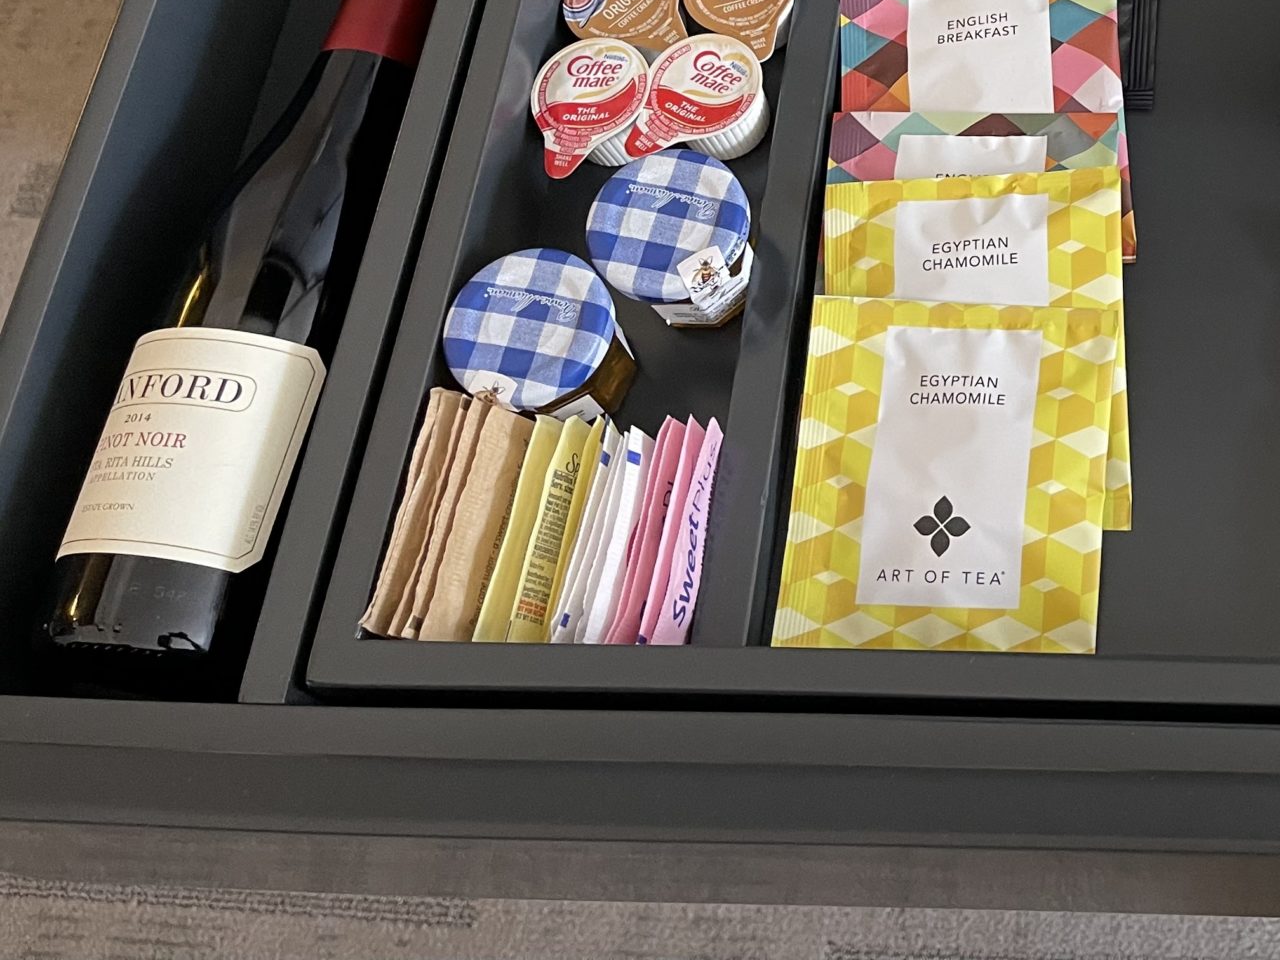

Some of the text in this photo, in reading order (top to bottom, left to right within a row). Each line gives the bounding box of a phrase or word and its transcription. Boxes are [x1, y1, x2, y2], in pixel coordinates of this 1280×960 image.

[723, 3, 746, 14] COFFEE
[947, 12, 1008, 30] ENGLISH
[937, 25, 1019, 45] BREAKFAST
[567, 55, 622, 77] Coffee
[694, 50, 742, 85] Coffee
[572, 76, 615, 88] mate
[690, 72, 729, 93] mate
[665, 102, 706, 122] ORIGINAL
[680, 101, 699, 112] THE
[563, 112, 610, 121] ORIGINAL
[932, 237, 1009, 254] EGYPTIAN
[922, 253, 1019, 272] CHAMOMILE
[920, 375, 999, 389] EGYPTIAN
[909, 392, 1006, 406] CHAMOMILE
[124, 412, 152, 423] 2014
[135, 431, 187, 449] NOIR
[104, 456, 128, 468] RITA
[131, 456, 173, 469] HILLS
[876, 569, 915, 583] ART
[924, 570, 951, 584] OF
